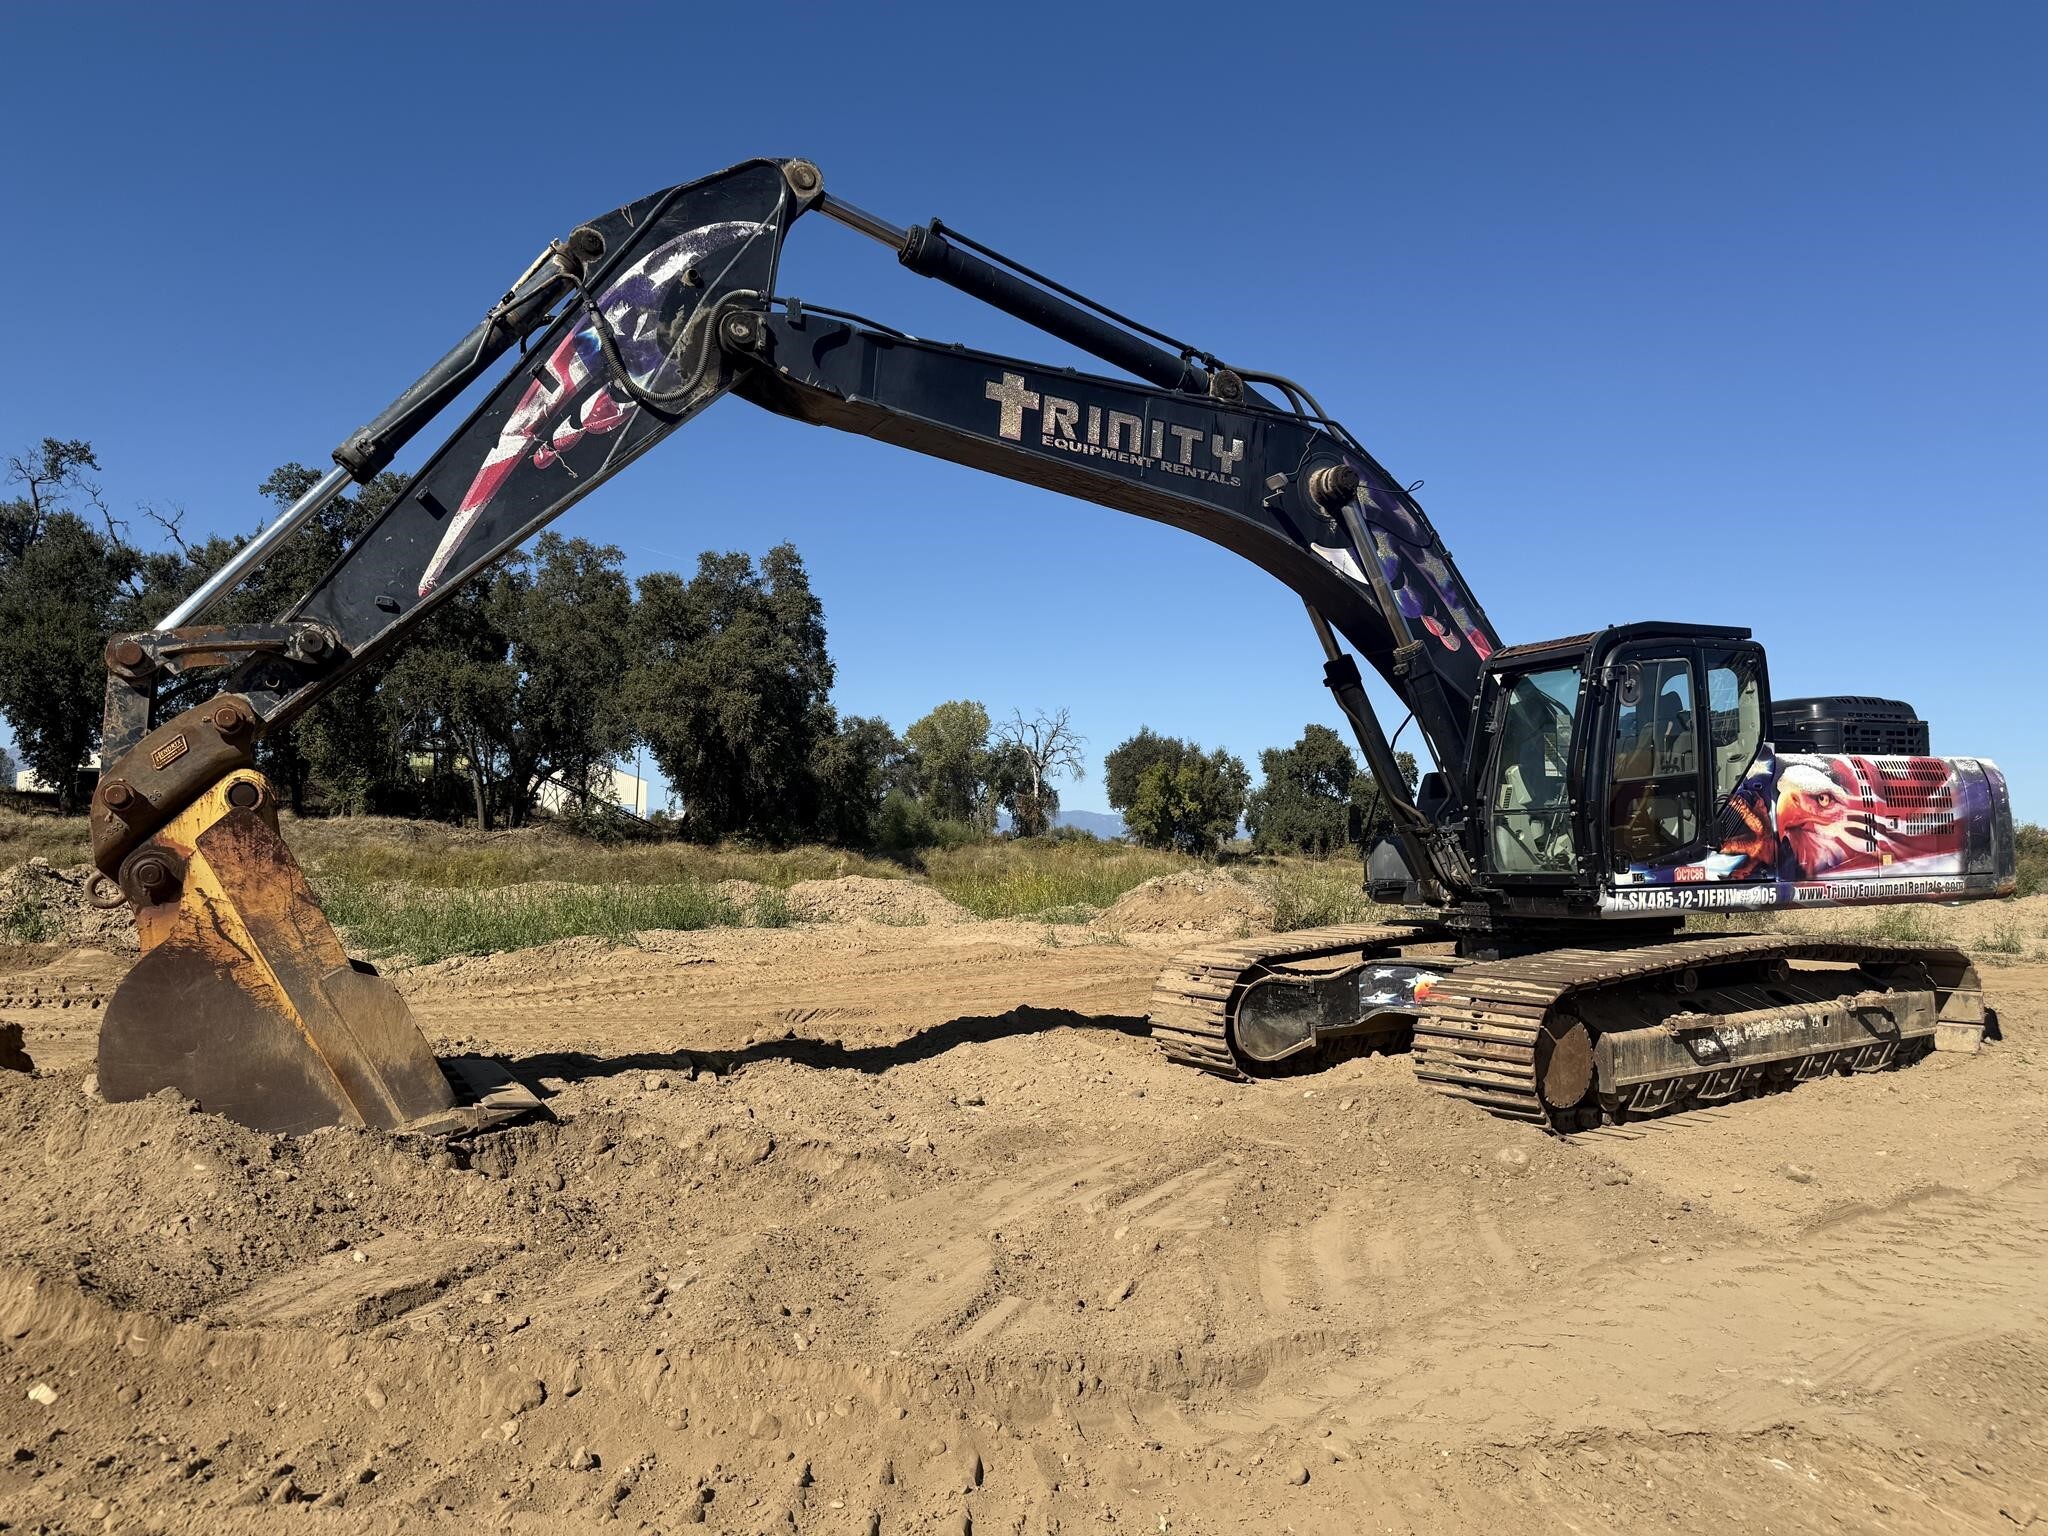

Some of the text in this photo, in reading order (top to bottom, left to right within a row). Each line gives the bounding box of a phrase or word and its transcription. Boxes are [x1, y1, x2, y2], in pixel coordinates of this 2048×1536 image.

[985, 371, 1244, 475] TRINITY
[1041, 434, 1241, 487] EQUIPMENT RENTALS
[1799, 880, 1965, 900] www.TrinityEquipmentRentals.com
